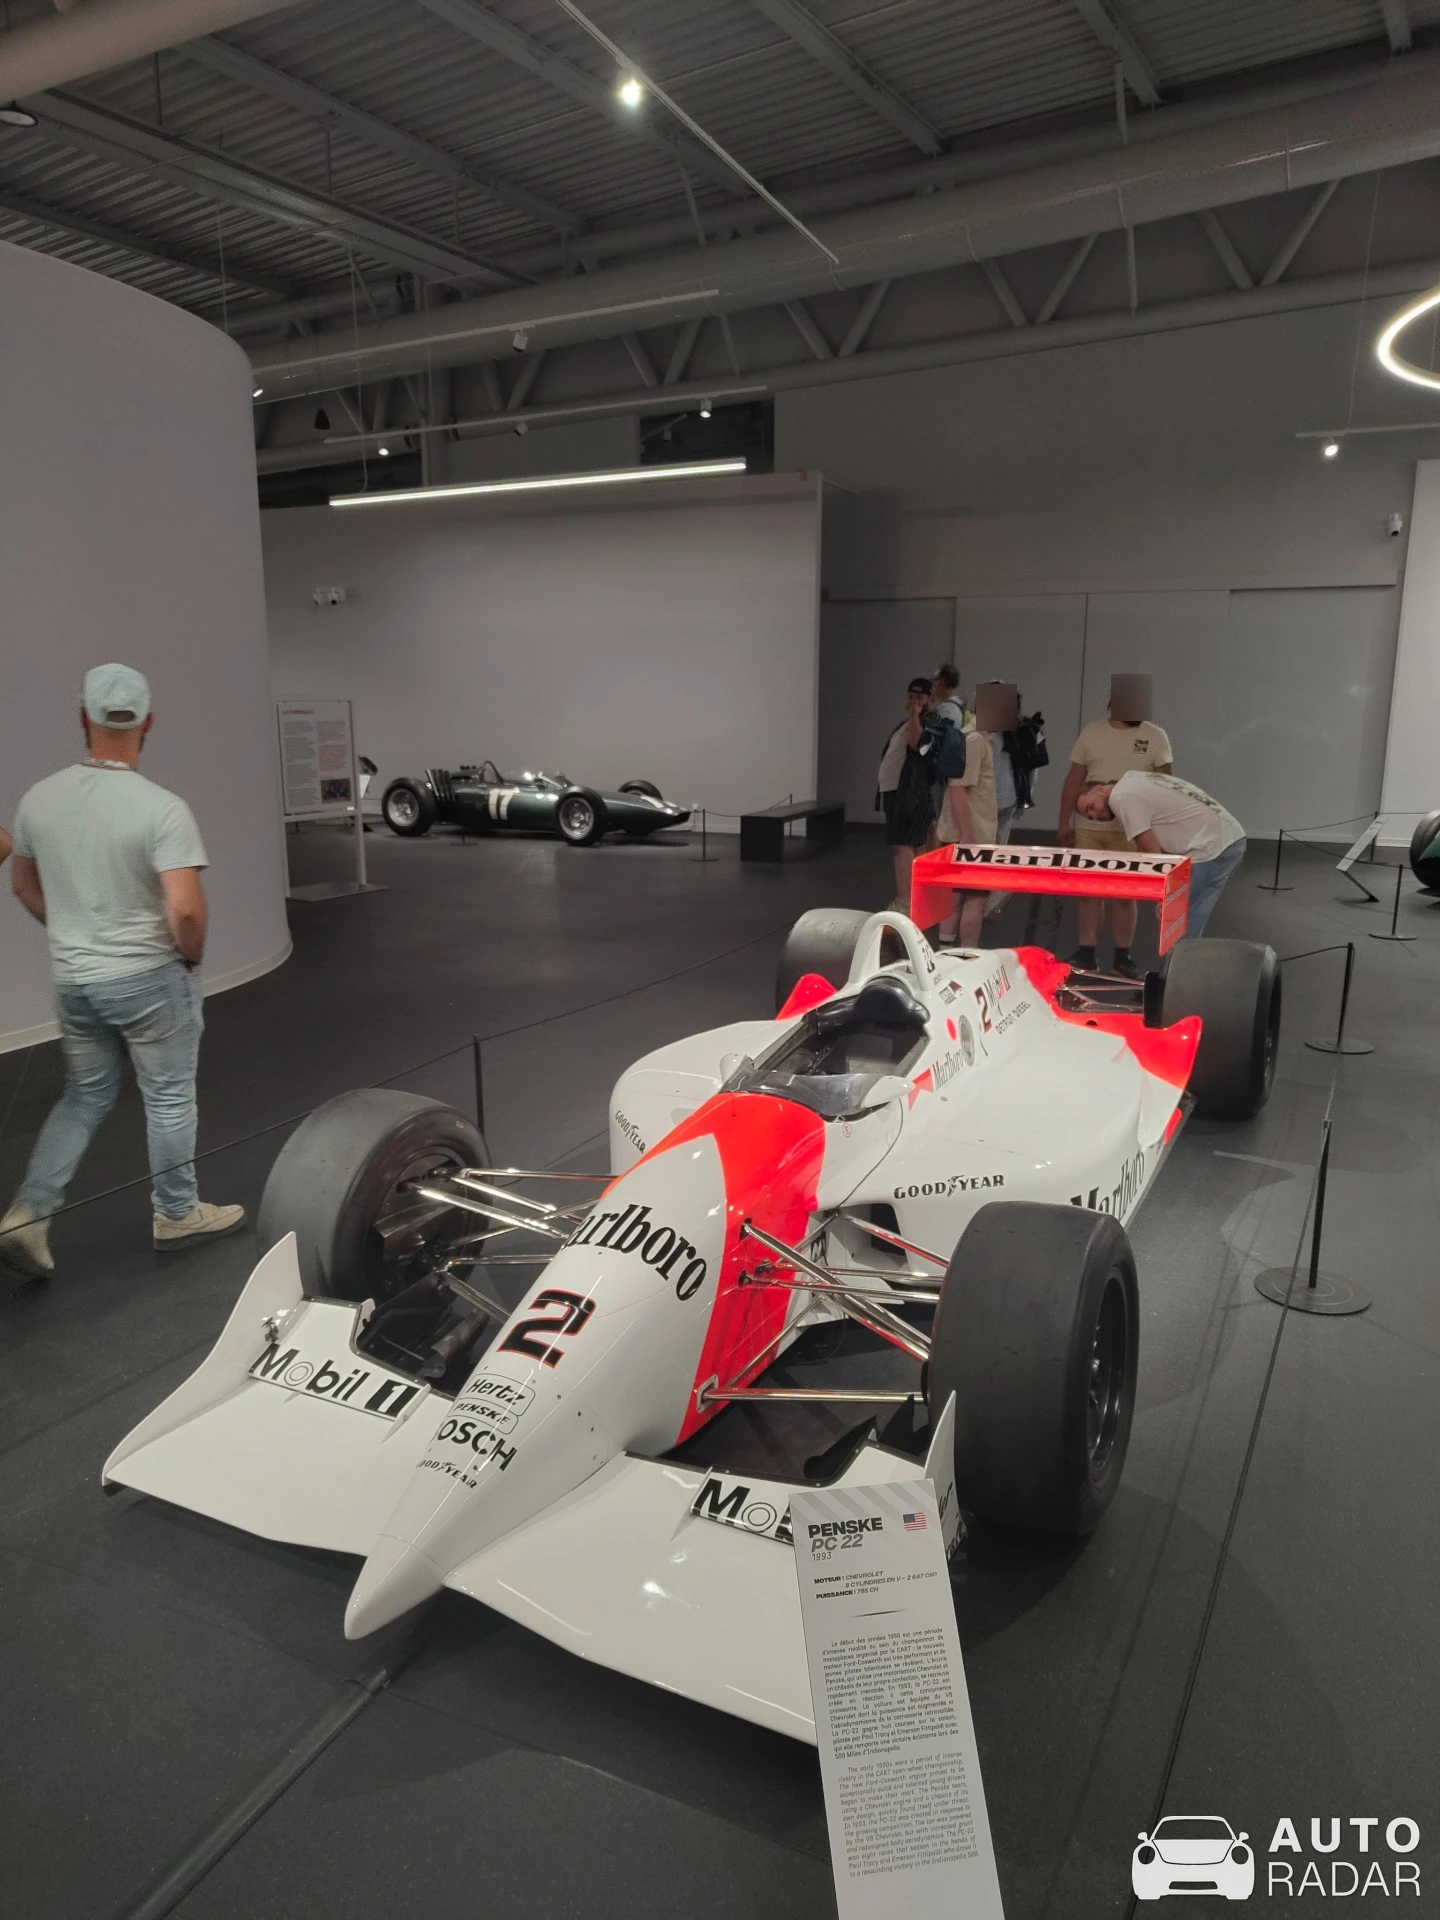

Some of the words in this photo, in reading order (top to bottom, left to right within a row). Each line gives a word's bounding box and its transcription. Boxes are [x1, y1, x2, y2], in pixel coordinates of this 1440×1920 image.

[488, 788, 514, 820] 17
[955, 848, 1177, 874] Marlboro
[974, 986, 993, 1034] 2
[1011, 1000, 1032, 1018] DIESEL
[931, 1048, 964, 1091] Marlboro
[565, 1203, 707, 1301] arlboro
[496, 1288, 597, 1370] 2
[248, 1342, 371, 1402] Mobil
[465, 1378, 526, 1406] Hertz
[453, 1402, 511, 1426] PENSKE
[433, 1418, 518, 1472] OSCH
[417, 1459, 478, 1490] OODYEAR
[808, 1517, 883, 1538] PENSKE
[811, 1537, 837, 1552] PC
[840, 1534, 864, 1549] 22
[811, 1552, 832, 1561] 1993
[814, 1576, 841, 1584] MOTEUR
[845, 1571, 884, 1581] CHEVROLET
[850, 1578, 886, 1588] CYLINDRES
[816, 1590, 853, 1599] PUISSANCE
